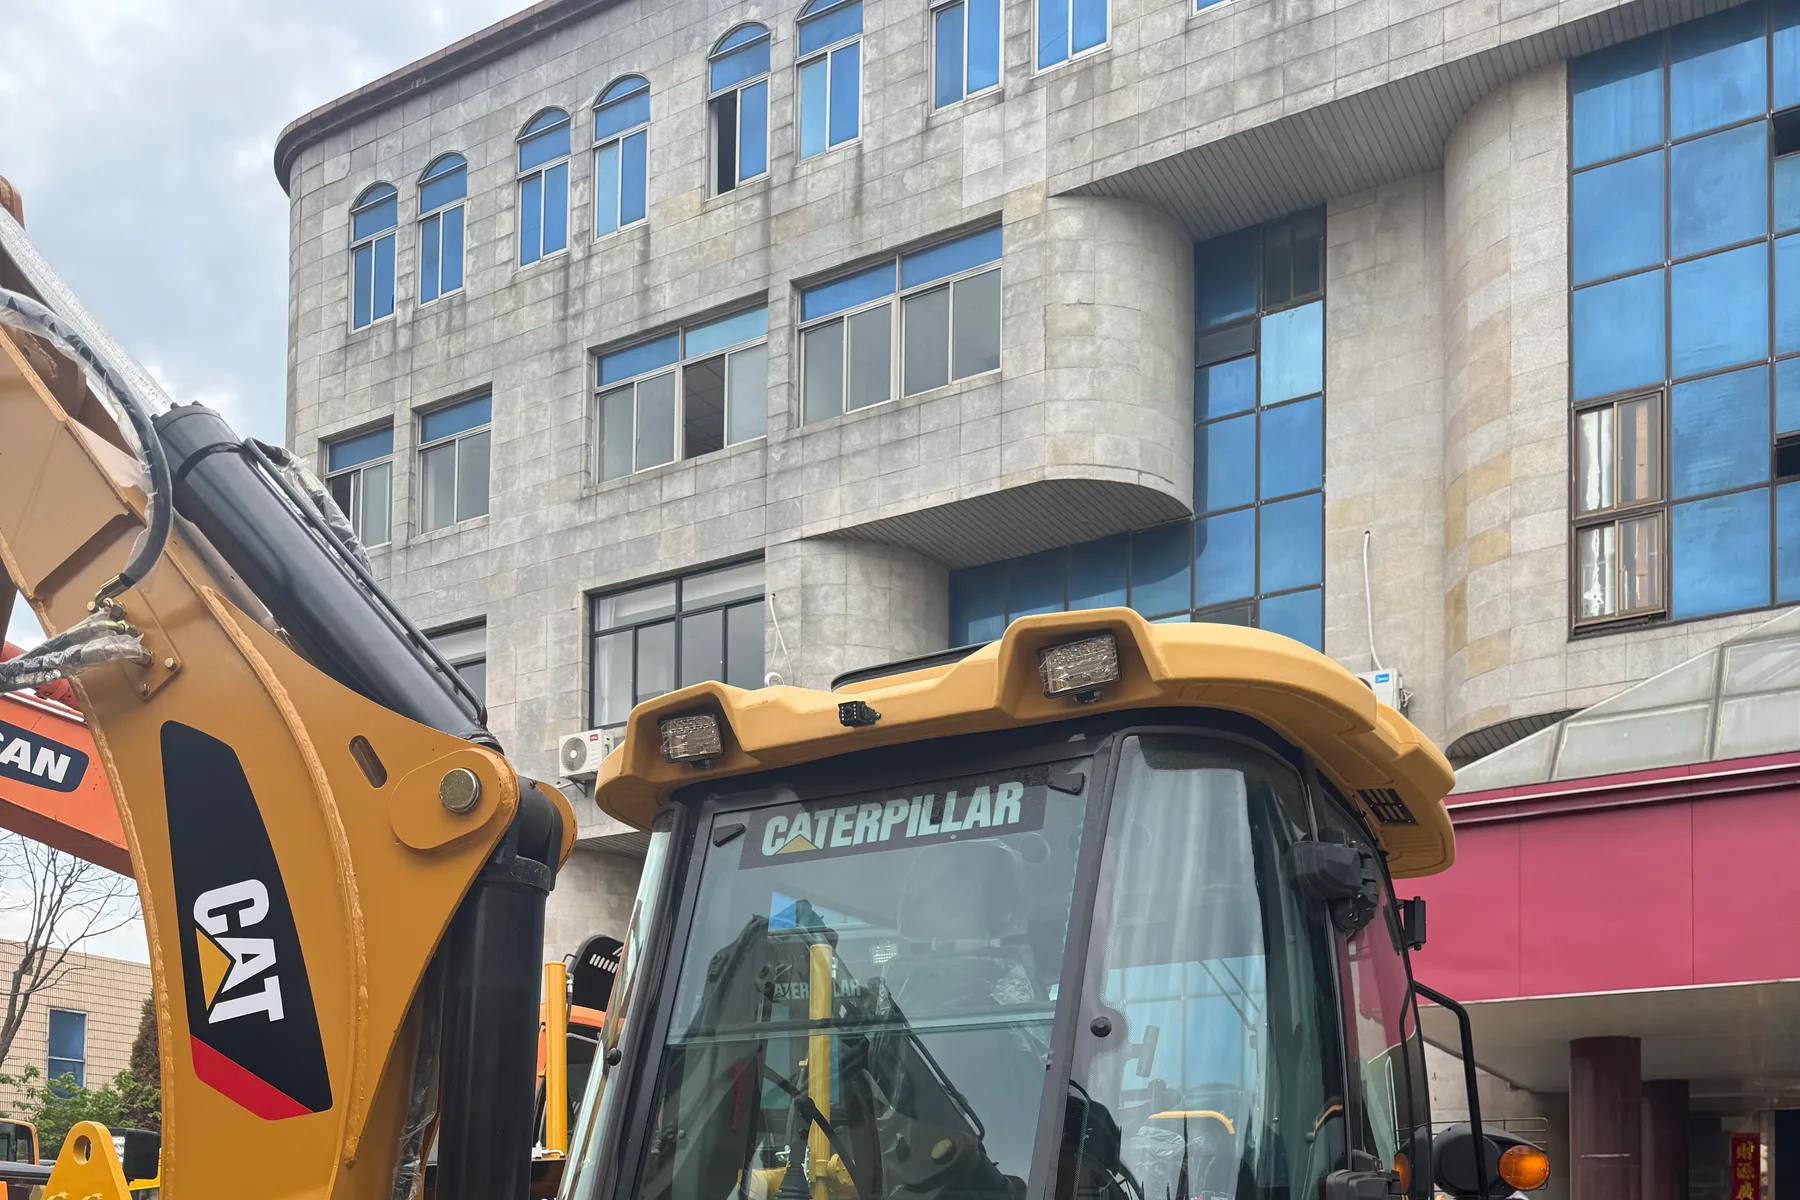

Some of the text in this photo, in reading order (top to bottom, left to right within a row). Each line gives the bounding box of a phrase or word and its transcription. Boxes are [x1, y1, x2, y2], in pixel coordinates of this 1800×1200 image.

[0, 731, 71, 784] AN
[762, 781, 1024, 856] CATERPILLAR
[193, 878, 285, 1024] CAT
